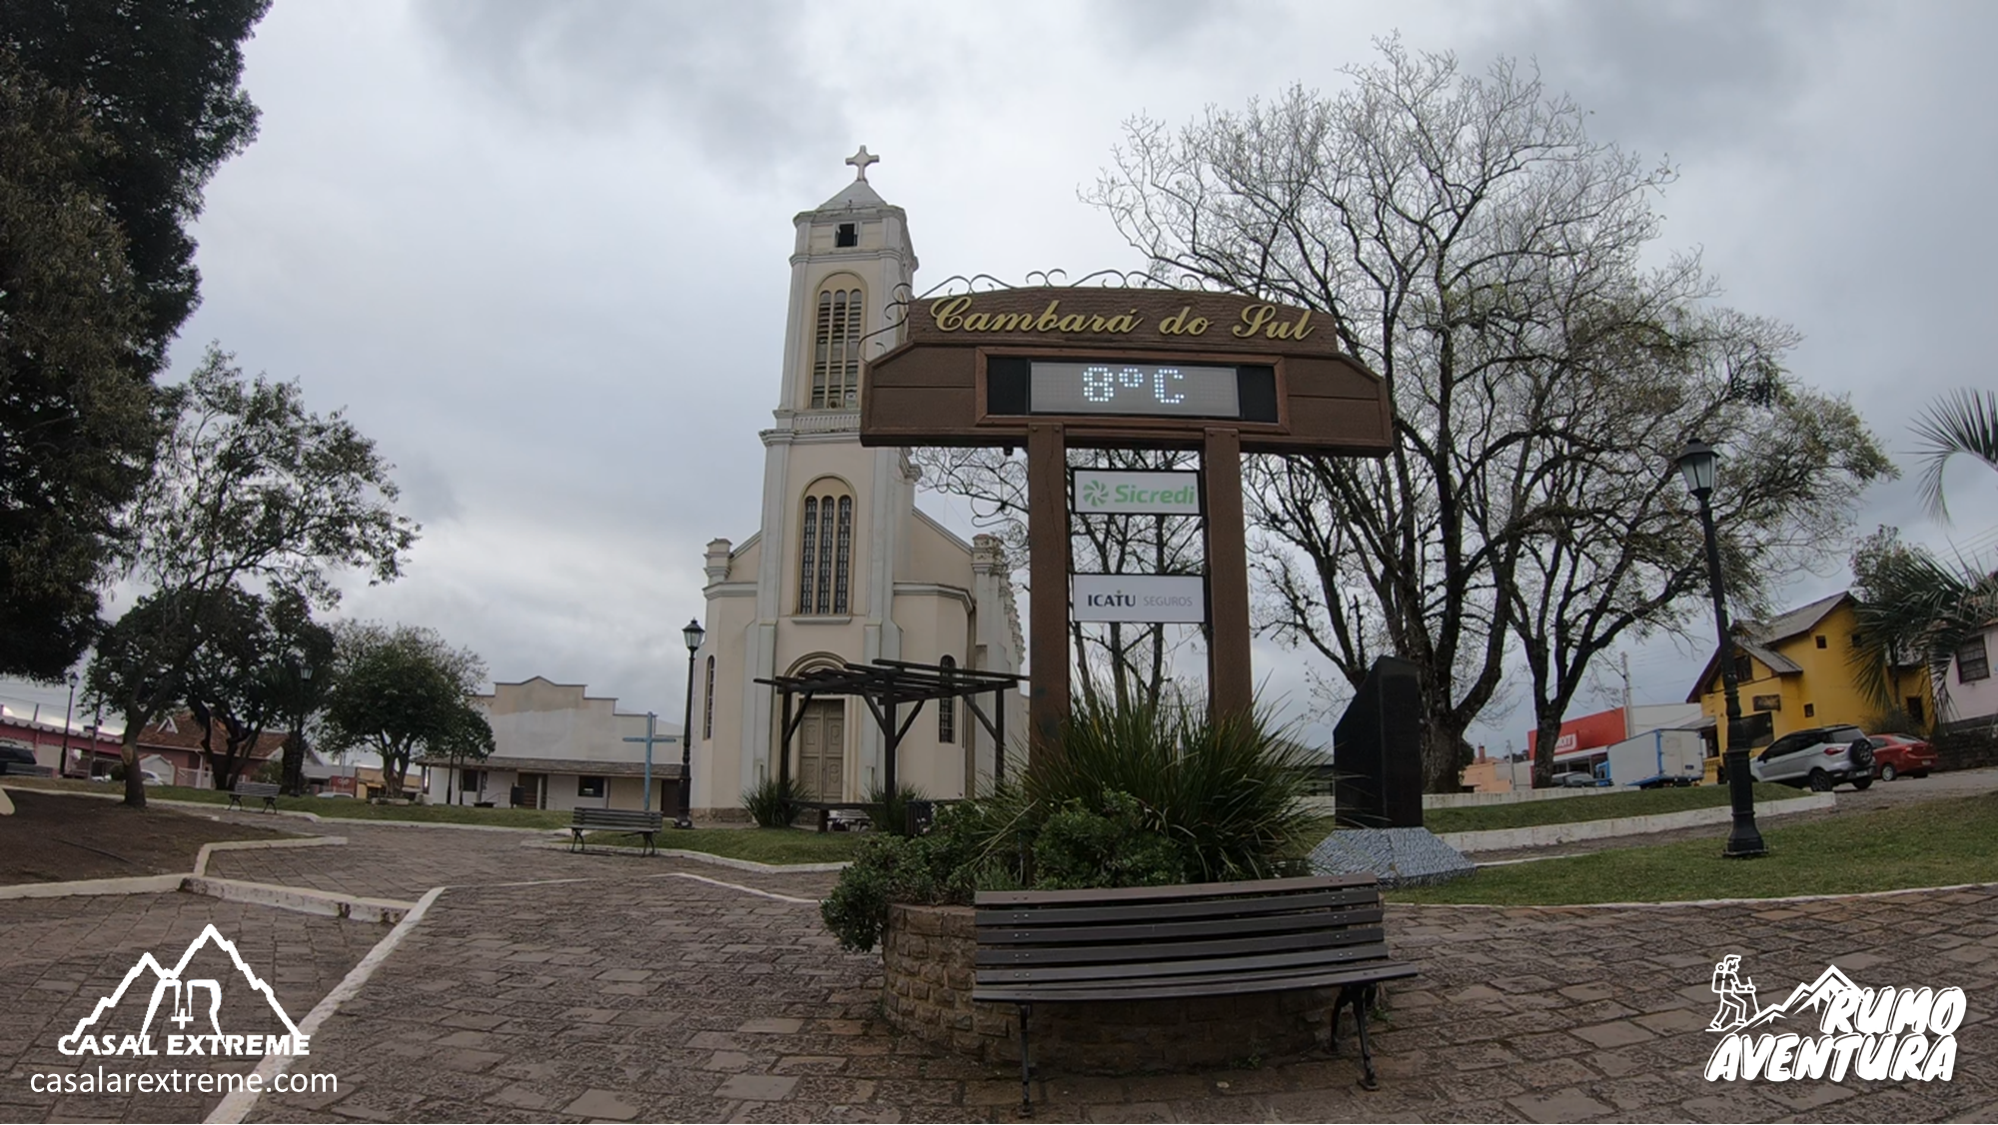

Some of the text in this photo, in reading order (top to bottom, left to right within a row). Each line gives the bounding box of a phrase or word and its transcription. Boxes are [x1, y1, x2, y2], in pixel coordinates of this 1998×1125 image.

[930, 296, 1316, 341] Cambará do Sul
[1114, 484, 1196, 505] Sicredi
[1087, 592, 1193, 607] ICATU SEGUROS
